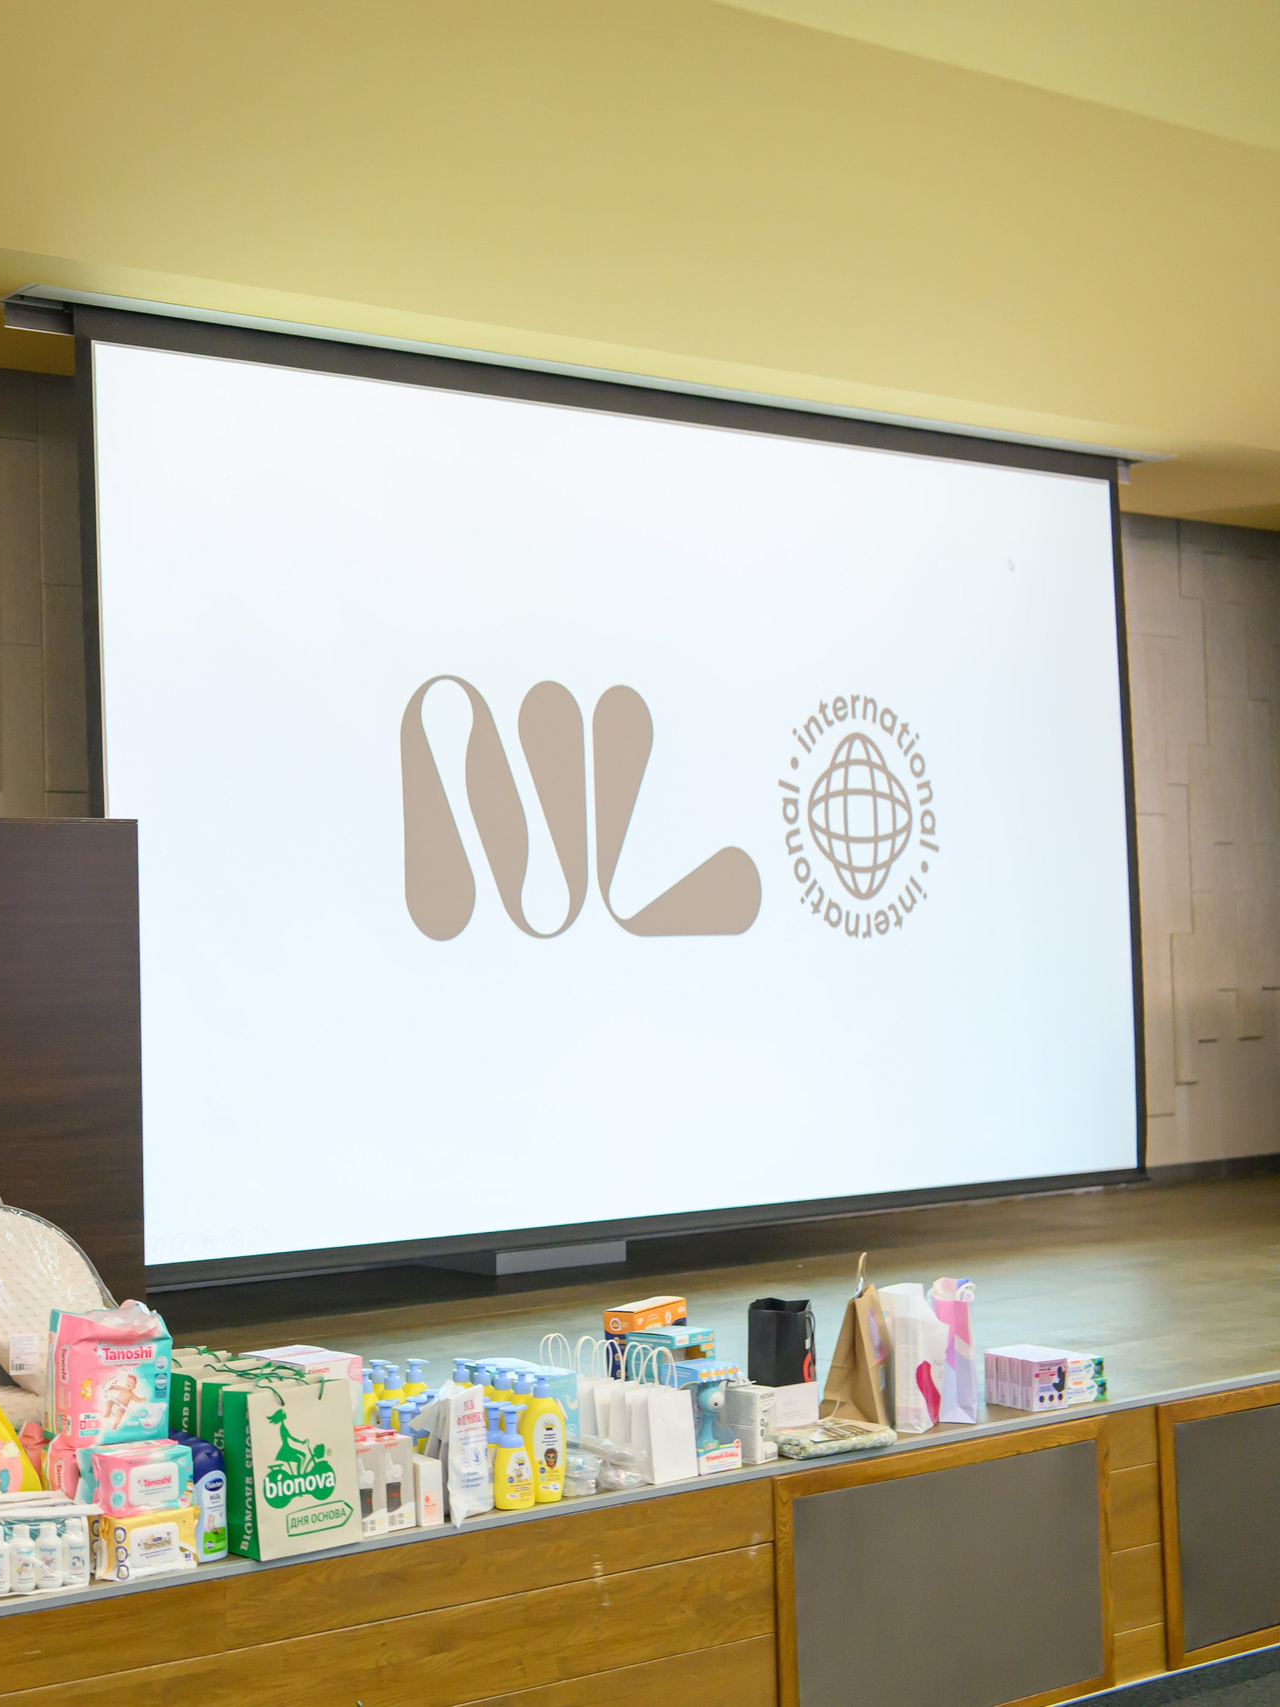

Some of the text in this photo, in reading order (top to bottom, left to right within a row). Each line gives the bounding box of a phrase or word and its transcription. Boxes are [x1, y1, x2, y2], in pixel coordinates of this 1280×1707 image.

[791, 693, 940, 853] international
[777, 778, 928, 939] international
[102, 1346, 153, 1361] Tanoshi
[264, 1471, 336, 1499] bionova
[290, 1506, 347, 1529] ДНЯ ОСНОВА
